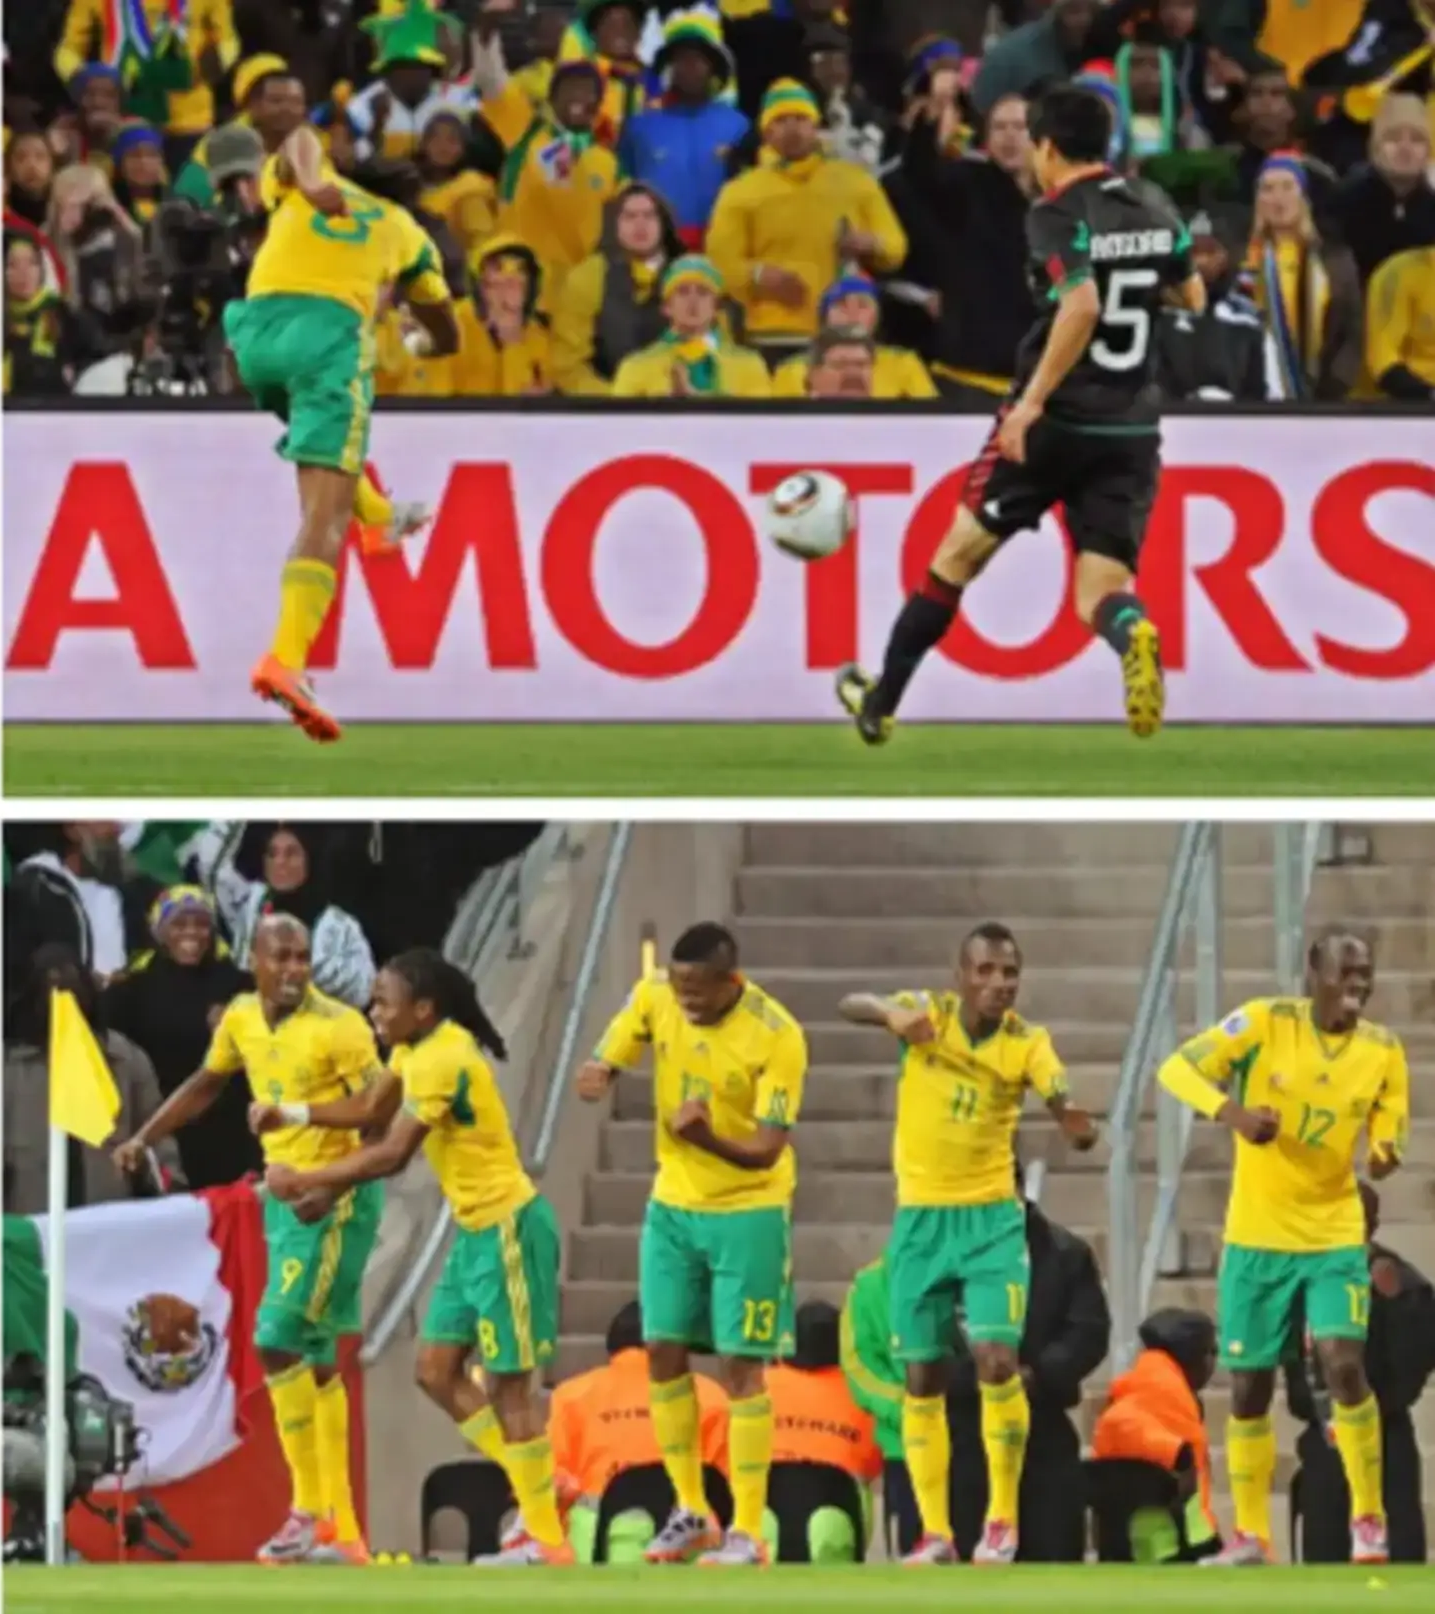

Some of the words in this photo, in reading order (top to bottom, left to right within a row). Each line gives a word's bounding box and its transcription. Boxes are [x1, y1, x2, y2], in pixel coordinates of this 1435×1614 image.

[1090, 268, 1159, 371] 5
[305, 453, 1435, 682] MOTORS
[1297, 1101, 1336, 1149] 12
[280, 1257, 303, 1295] 9
[477, 1317, 500, 1361] 8
[743, 1298, 777, 1341] 13
